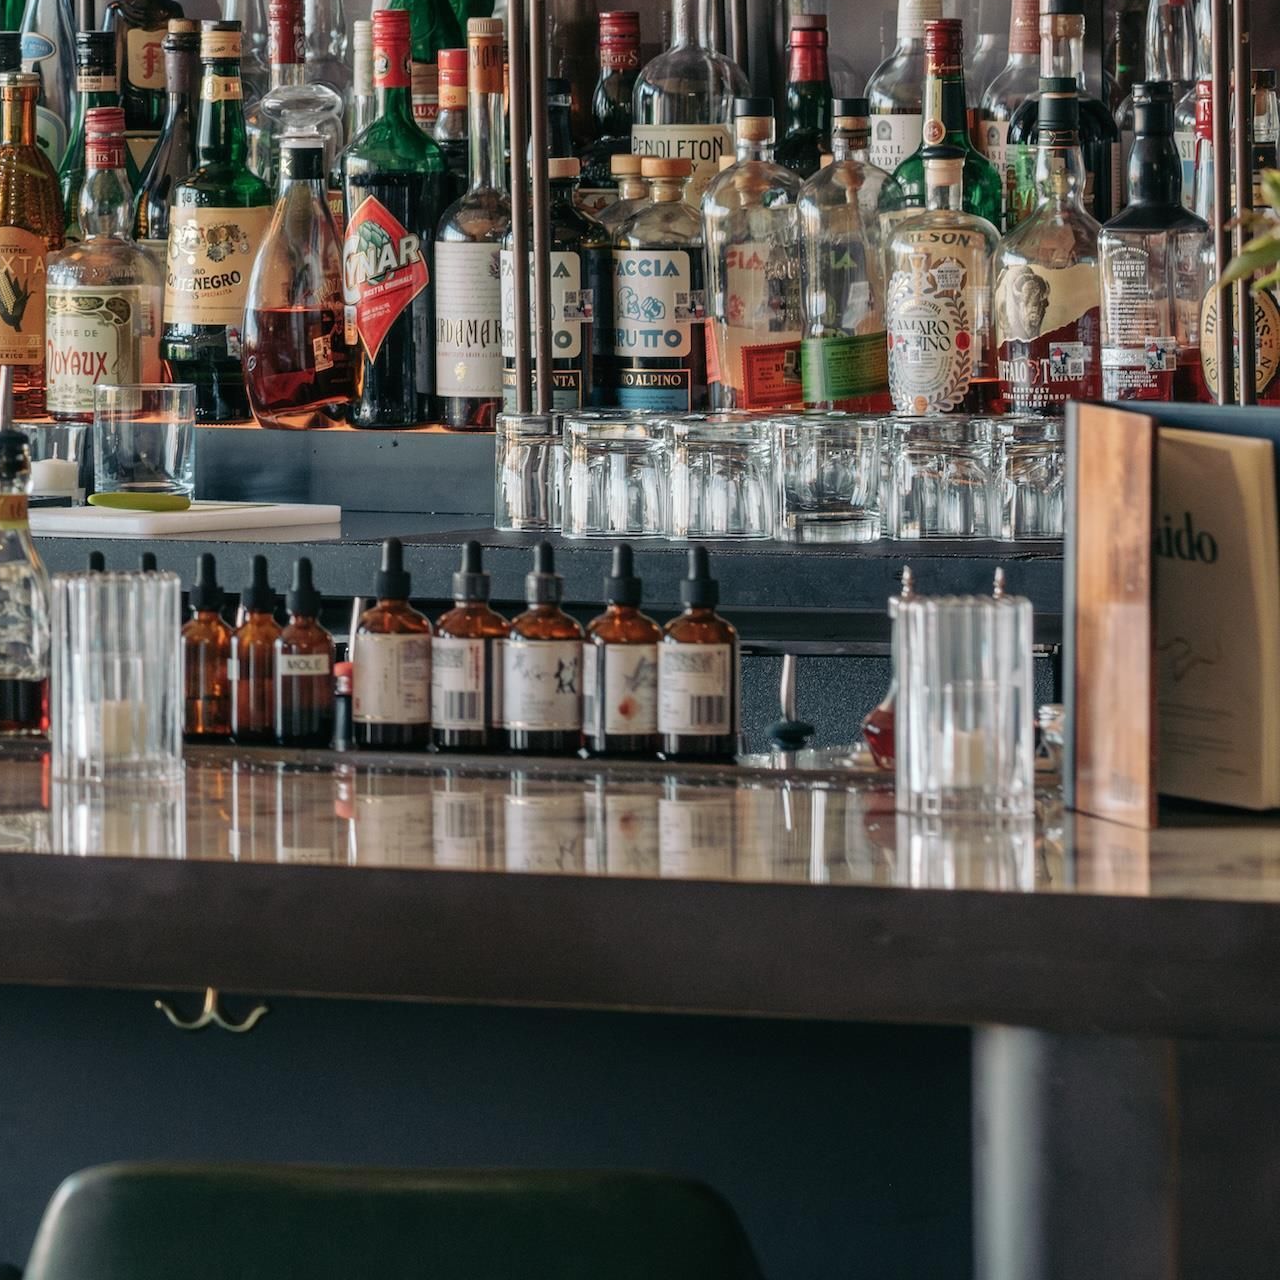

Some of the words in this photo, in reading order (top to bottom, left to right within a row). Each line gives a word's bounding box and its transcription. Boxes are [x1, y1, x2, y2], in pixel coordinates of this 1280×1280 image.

[633, 136, 723, 163] PENDLETON
[344, 232, 421, 307] CYNAR
[1113, 270, 1145, 278] WHISKEY
[84, 328, 99, 338] DE
[897, 320, 950, 336] AMARO
[635, 373, 682, 386] ALPINO
[1032, 393, 1072, 401] BOURBON
[1015, 400, 1048, 408] WHISKEY
[287, 658, 322, 672] MOLE
